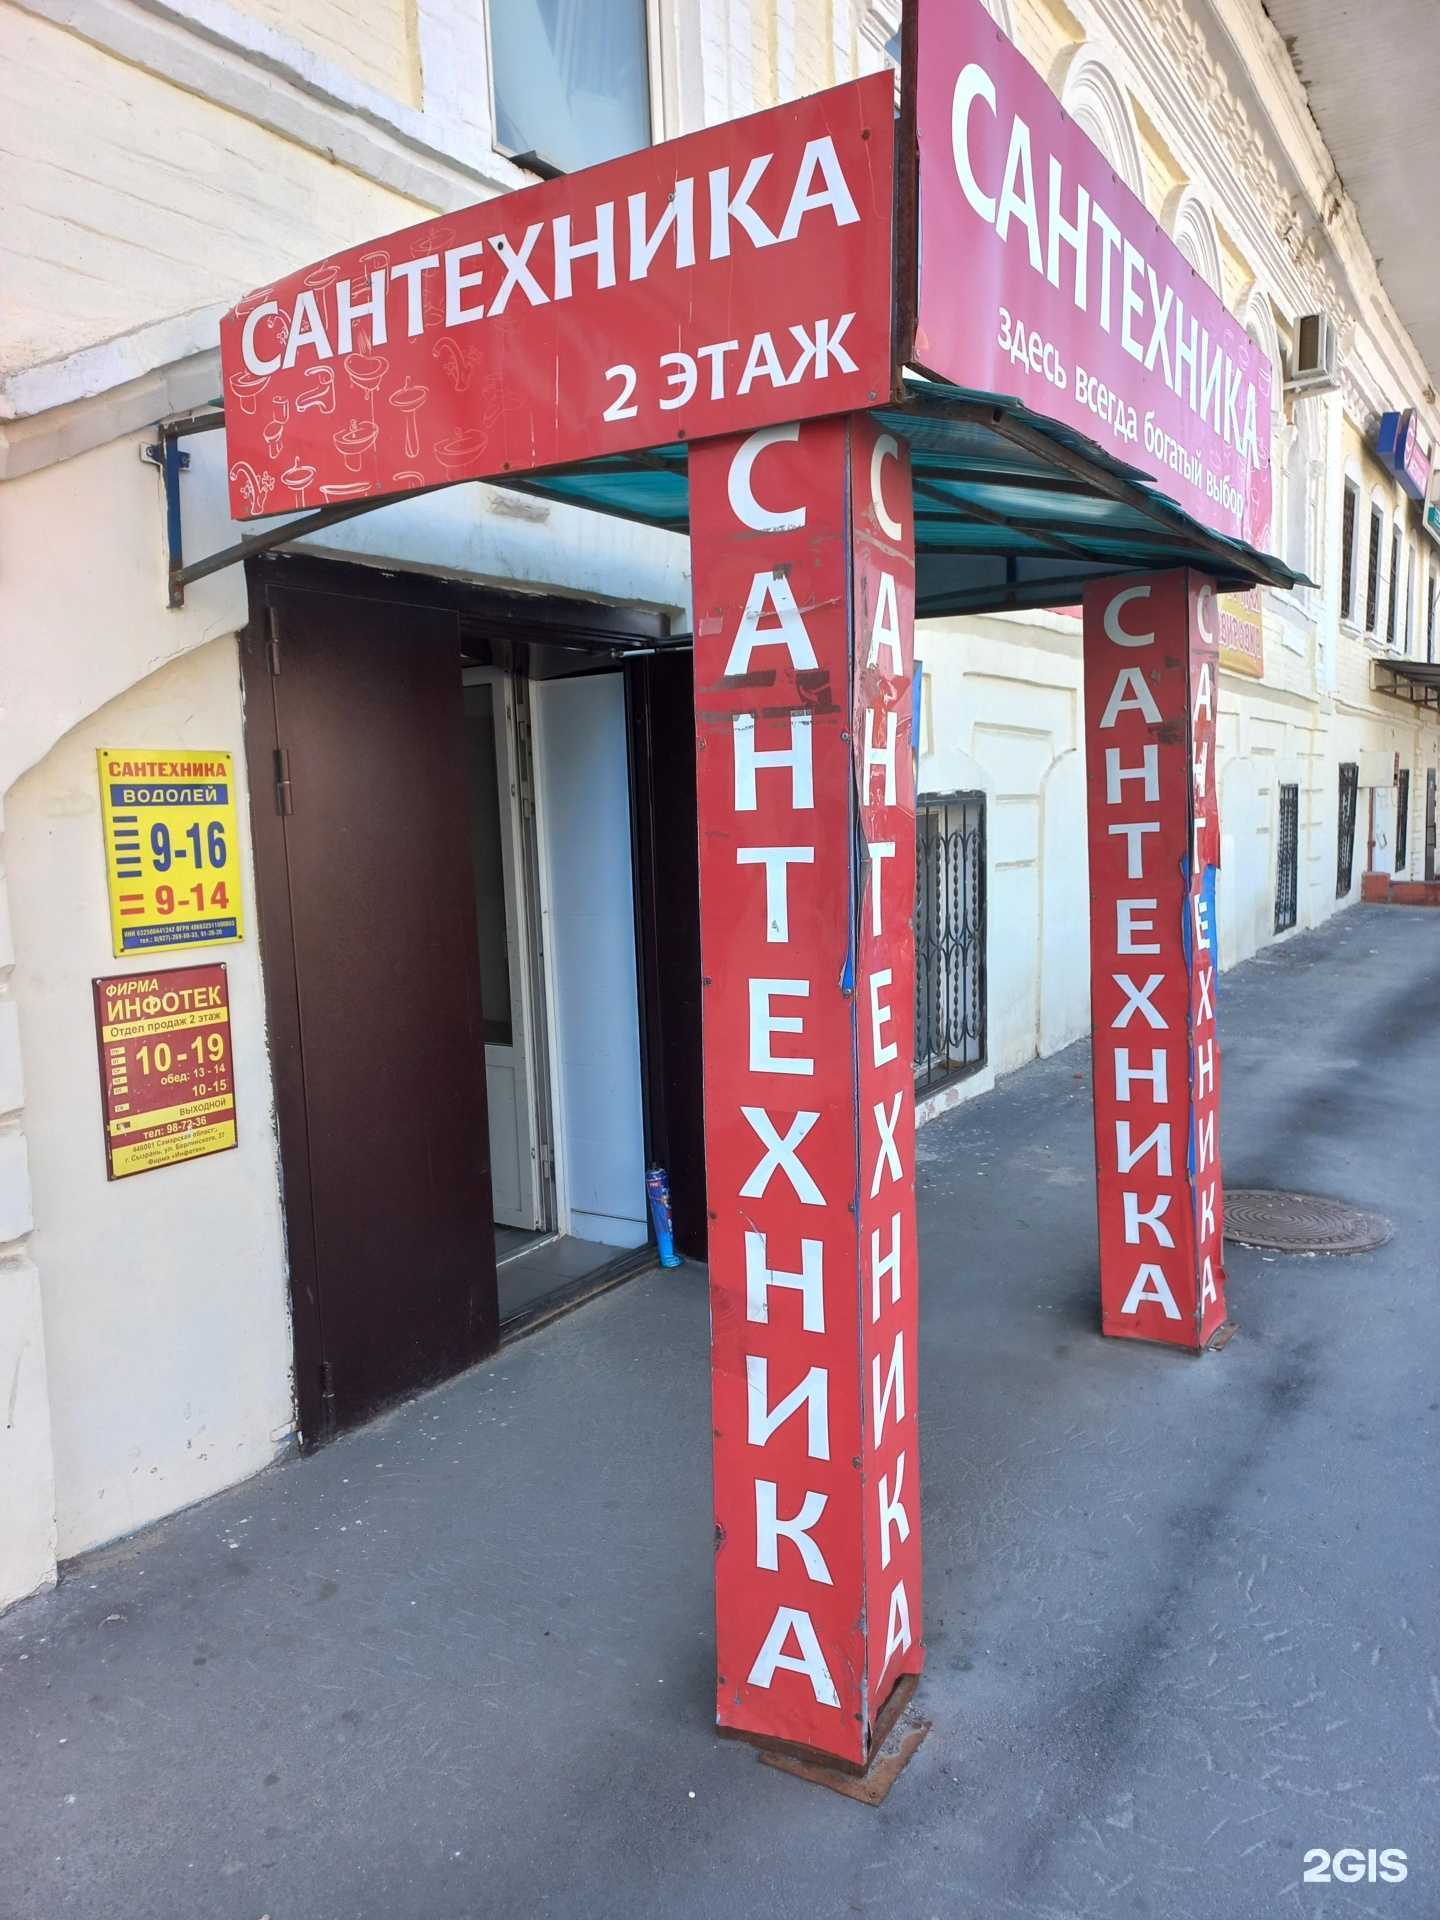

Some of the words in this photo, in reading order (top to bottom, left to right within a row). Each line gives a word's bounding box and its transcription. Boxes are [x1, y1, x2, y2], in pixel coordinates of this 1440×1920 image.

[241, 135, 860, 377] САНТЕХНИКА
[951, 63, 1261, 470] САНТЕХНИКА
[603, 364, 638, 422] 2
[658, 312, 858, 411] ЭТАЖ
[997, 307, 1067, 390] здесь
[1075, 365, 1138, 443] всегда
[1144, 411, 1202, 489] богатый
[1206, 470, 1243, 527] выбор
[108, 761, 227, 778] САНТЕХНИКА
[123, 785, 217, 803] ВОДОЛЕЙ
[150, 820, 227, 872] 9-16
[154, 881, 229, 916] 9-14
[1099, 585, 1183, 1321] САНТЕХНИКА
[105, 978, 159, 998] ФИРМА
[107, 985, 221, 1022] ИНФОТЕК
[110, 1025, 145, 1038] Отдел
[147, 1016, 187, 1034] продаж
[189, 1014, 196, 1024] 2
[198, 1011, 221, 1023] этаж
[160, 1072, 190, 1086] обед:
[724, 424, 842, 1709] САНТЕХНИКА
[863, 433, 912, 1693] САНТЕХНИКА
[179, 1098, 226, 1116] ВЫХОДНОЙ
[143, 1127, 164, 1139] тел:
[166, 1116, 207, 1133] 98-72-36
